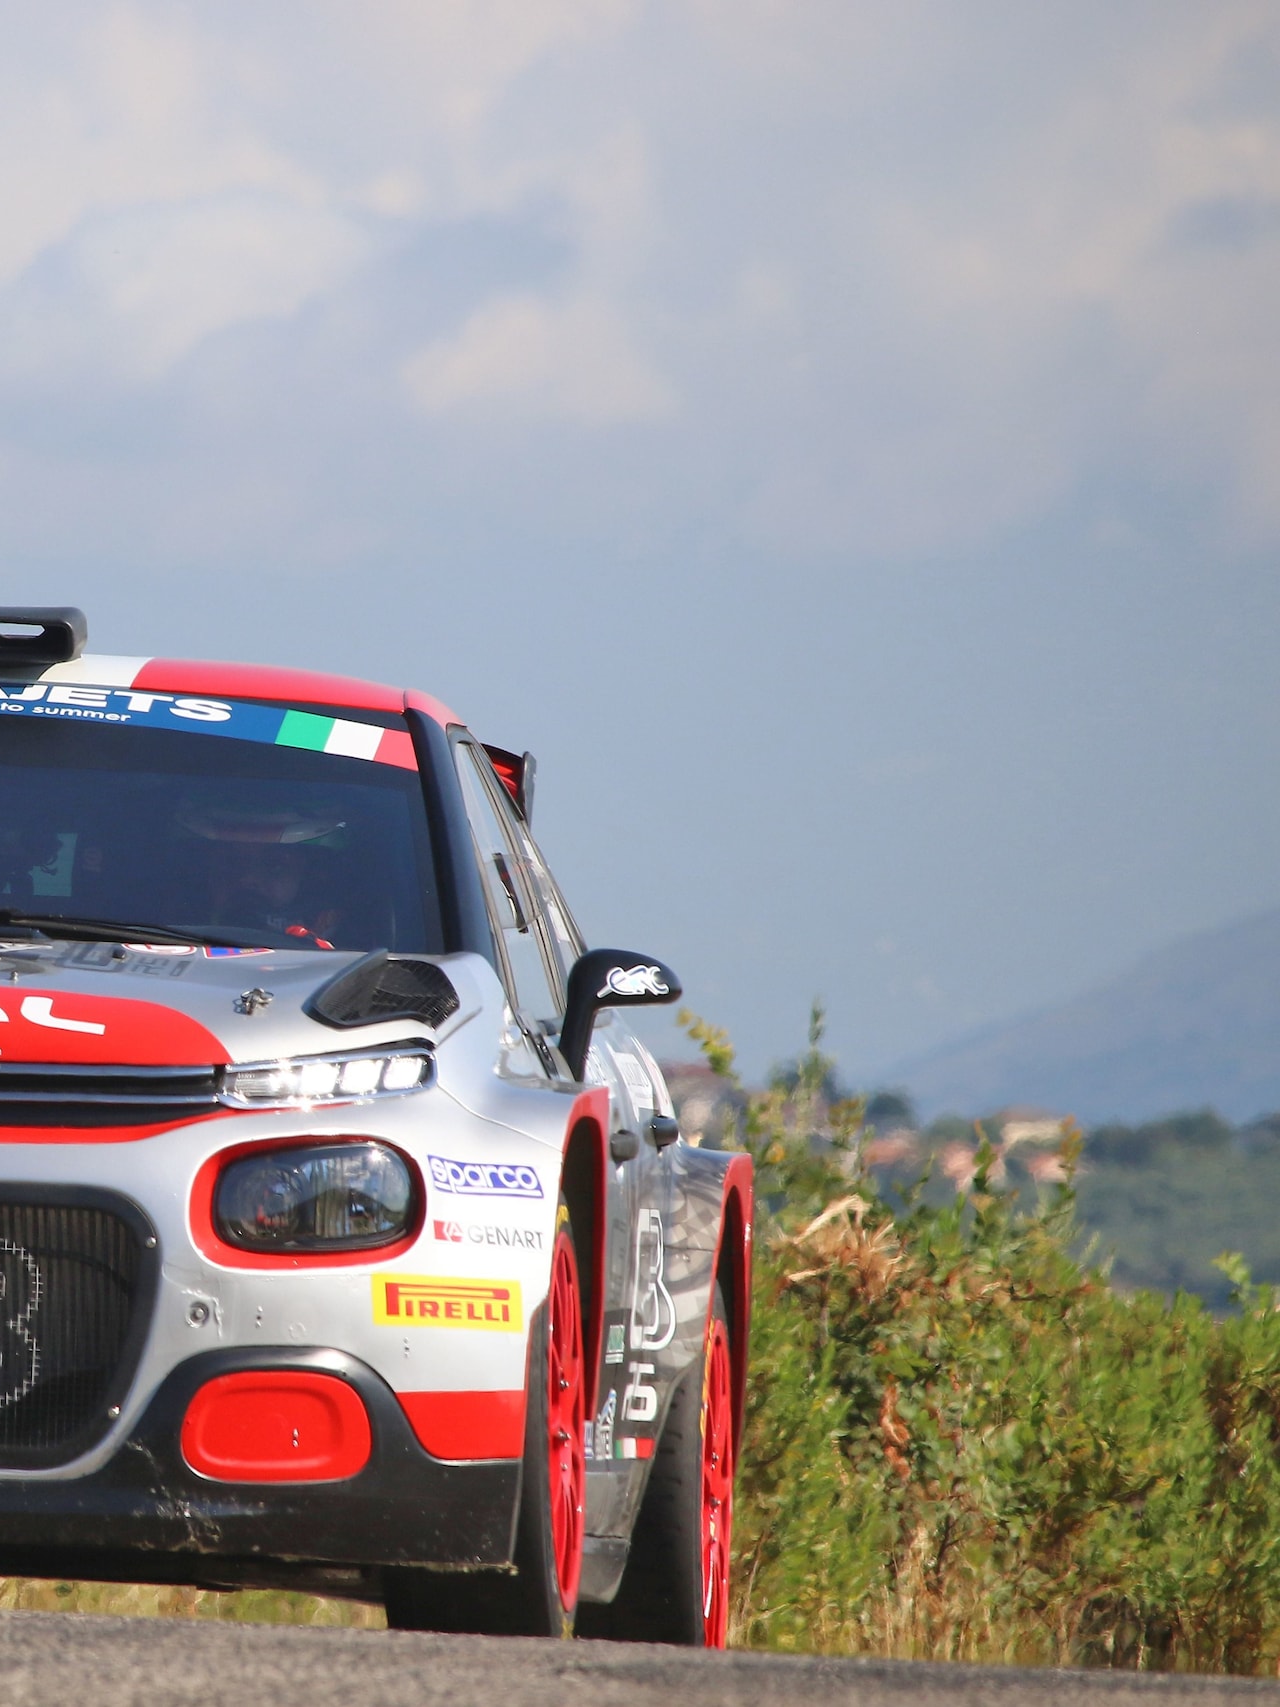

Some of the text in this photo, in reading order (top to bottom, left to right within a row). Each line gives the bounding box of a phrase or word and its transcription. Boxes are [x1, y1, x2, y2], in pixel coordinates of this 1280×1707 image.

[0, 702, 24, 713] to
[32, 707, 131, 722] summer
[431, 1157, 542, 1196] sparco
[468, 1224, 544, 1250] GENART
[385, 1282, 510, 1322] PIRELLI
